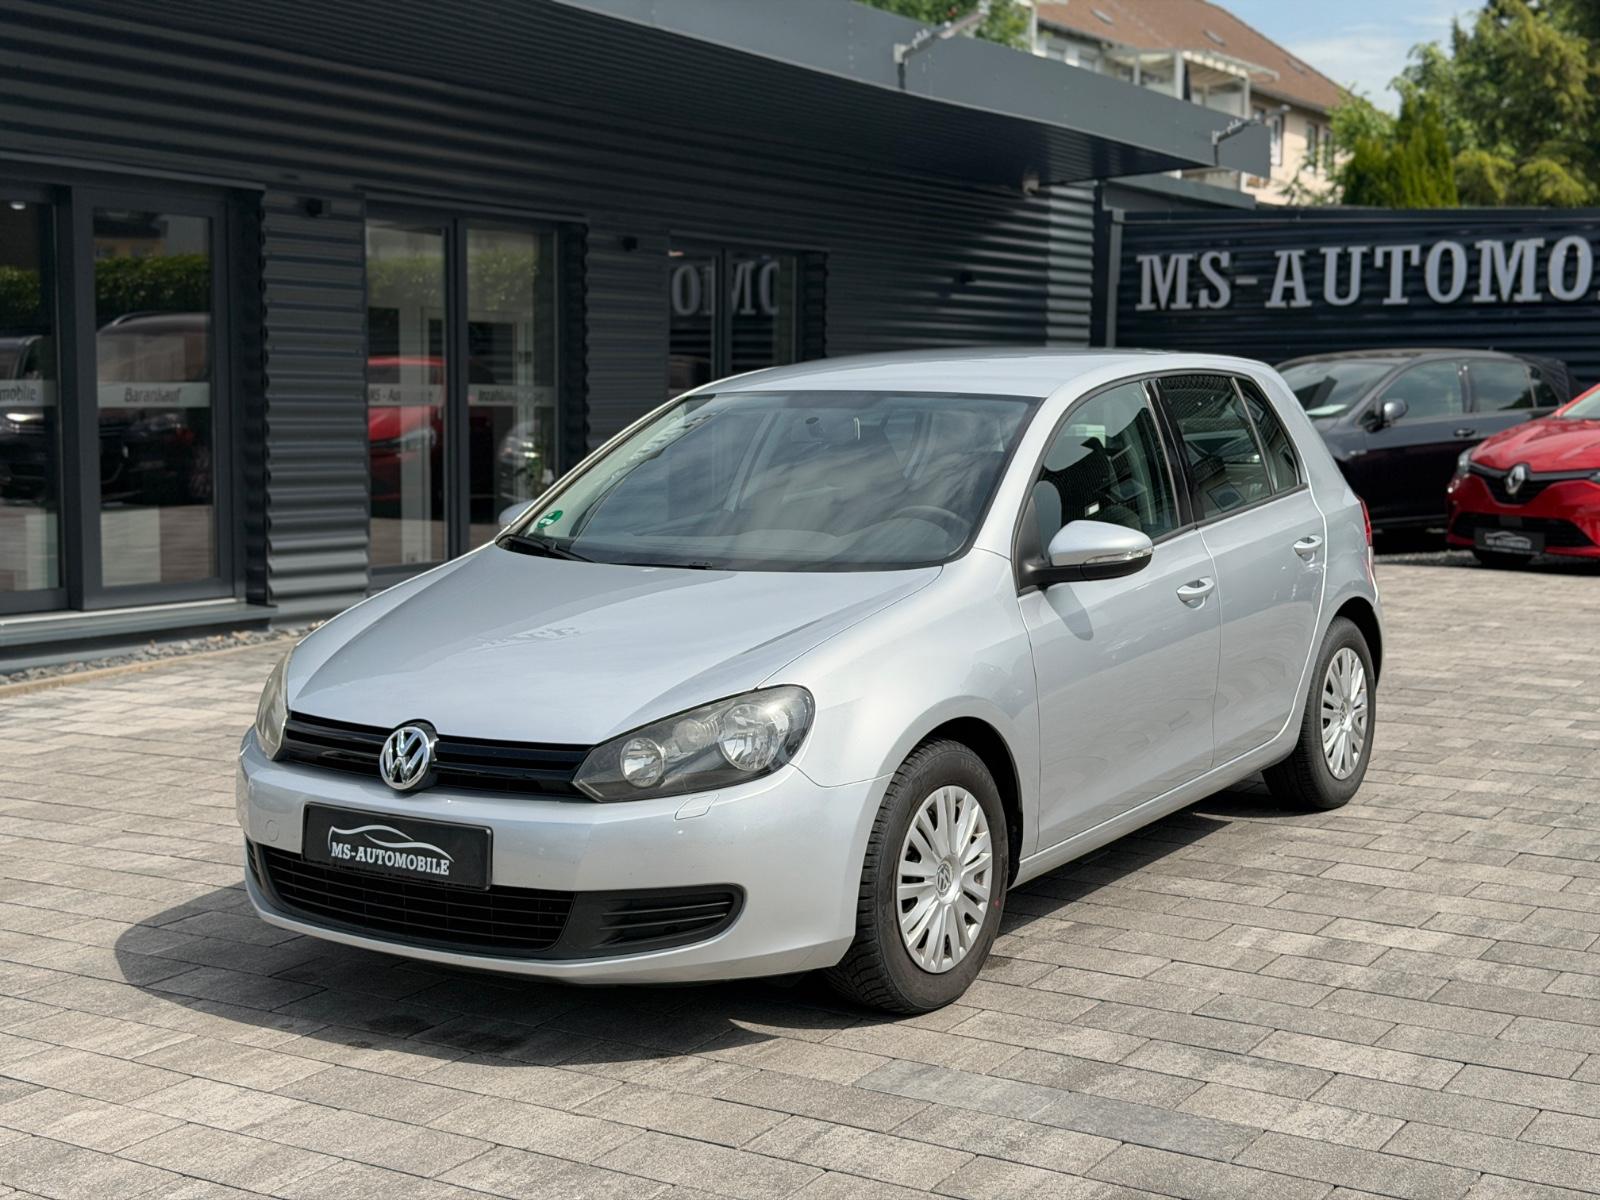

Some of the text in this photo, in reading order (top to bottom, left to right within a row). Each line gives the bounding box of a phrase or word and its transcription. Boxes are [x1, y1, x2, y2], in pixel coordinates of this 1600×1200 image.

[1135, 236, 1600, 310] MS-AUTOMO
[380, 726, 430, 790] VW
[331, 841, 450, 876] MS-AUTOMOBILE
